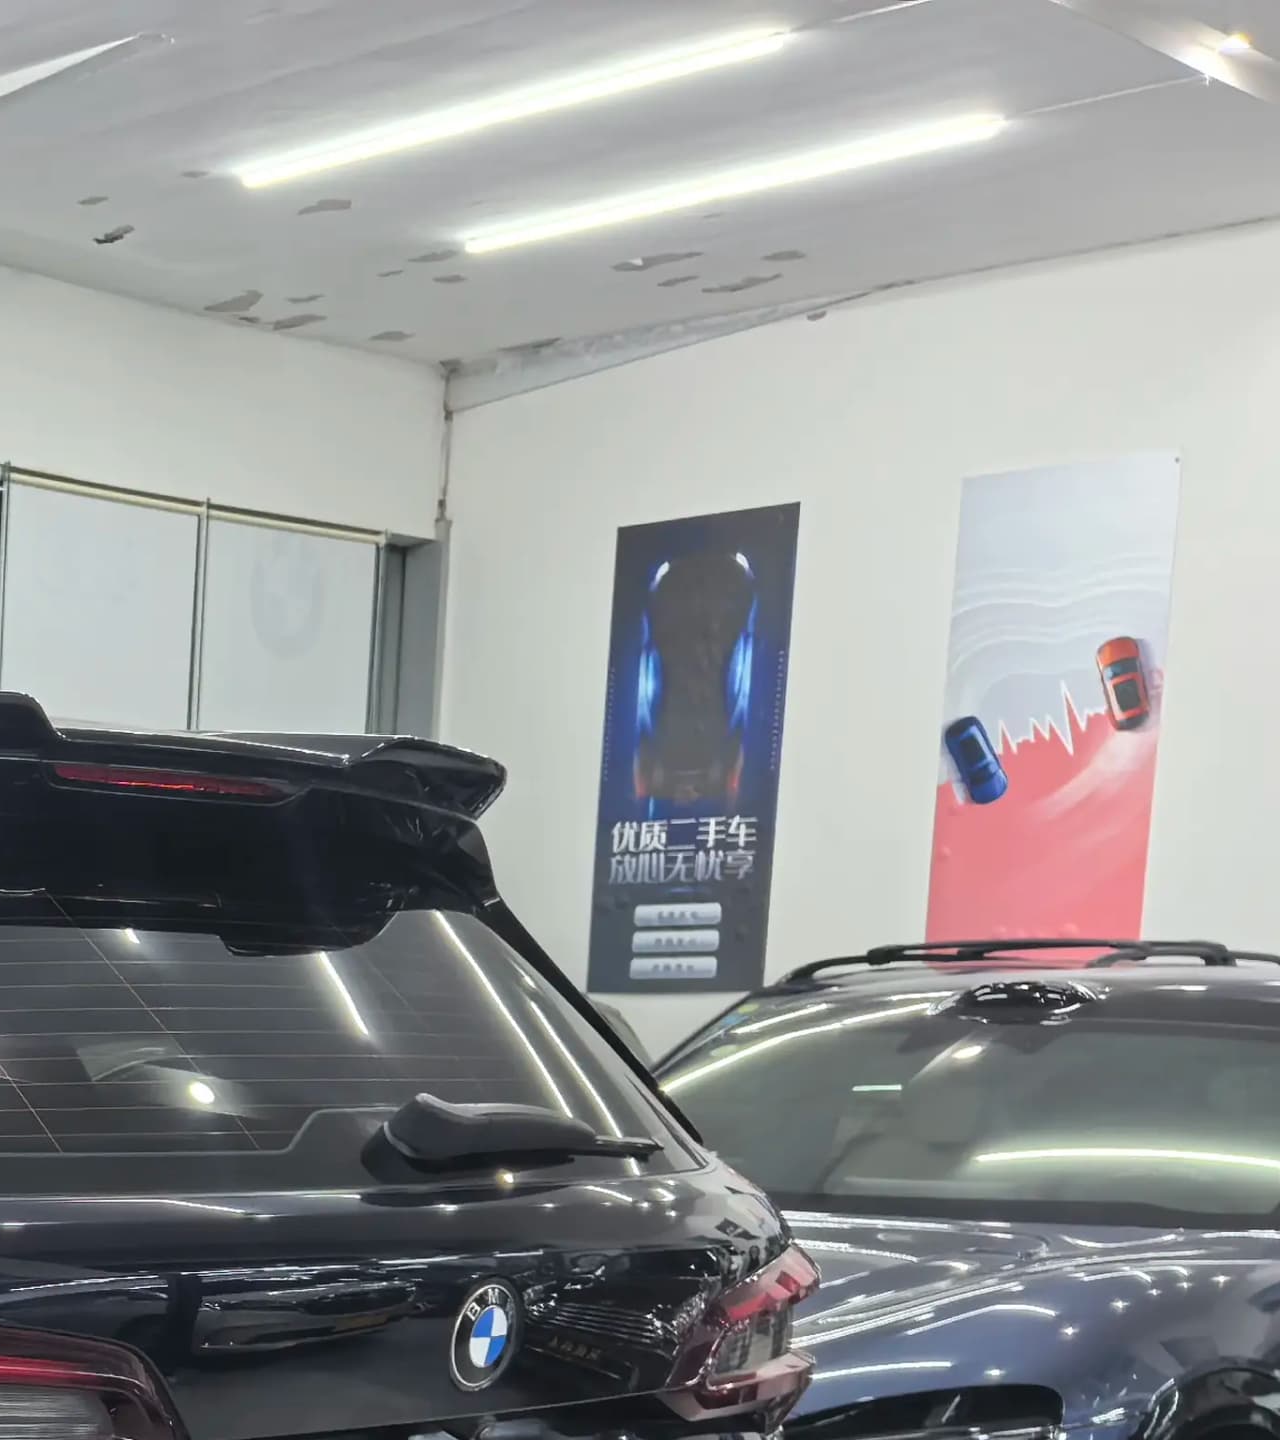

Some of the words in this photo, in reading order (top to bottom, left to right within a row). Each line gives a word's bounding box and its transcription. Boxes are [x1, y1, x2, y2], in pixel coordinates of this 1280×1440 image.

[611, 815, 758, 853] 优质二手车
[609, 849, 756, 884] 放心无忧享
